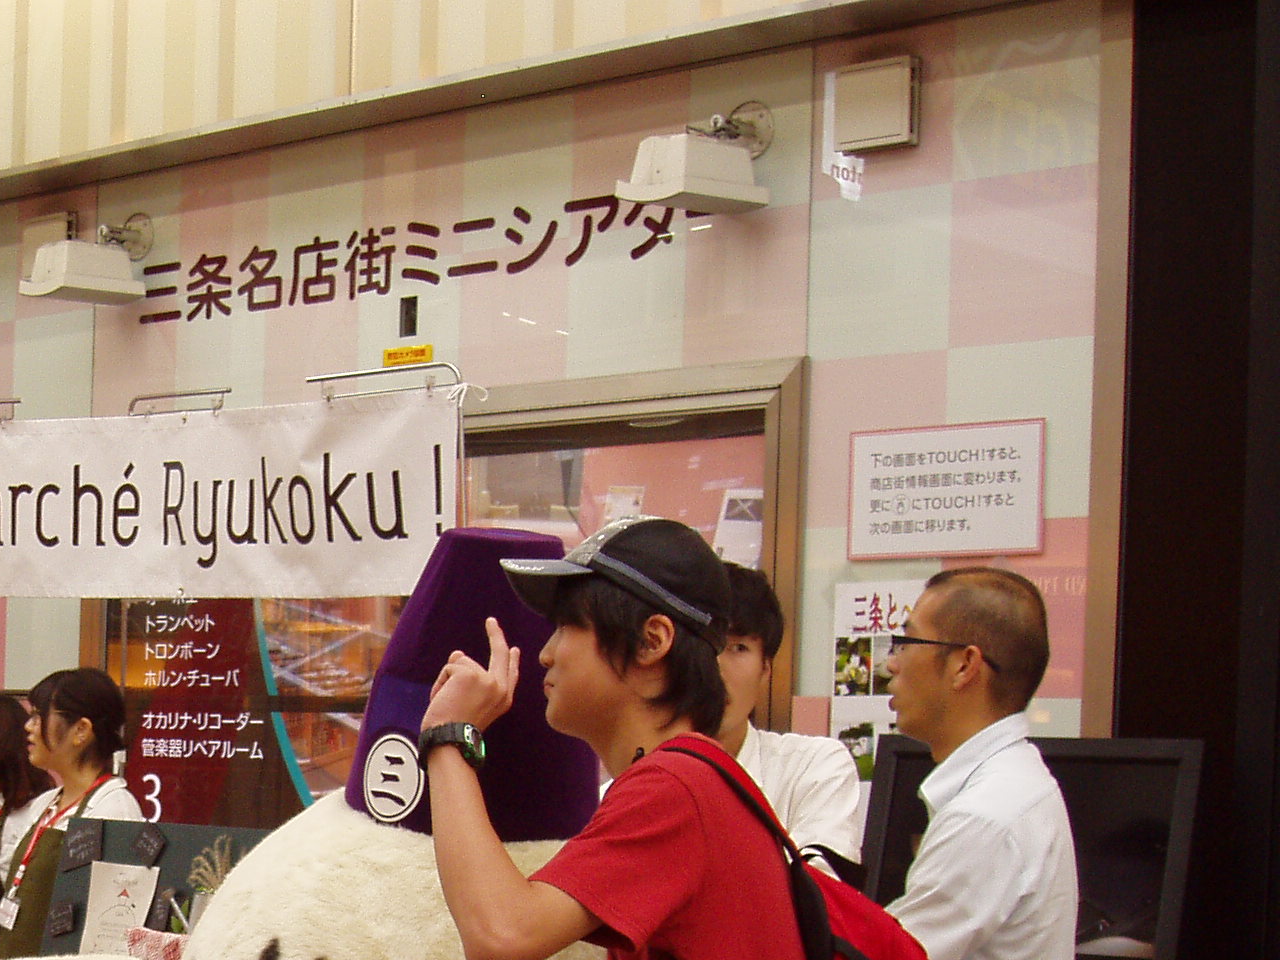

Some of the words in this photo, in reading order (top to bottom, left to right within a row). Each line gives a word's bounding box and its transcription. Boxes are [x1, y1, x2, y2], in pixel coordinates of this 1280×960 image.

[139, 193, 713, 324] 三条名店街ミニシアタ
[163, 451, 409, 569] Ryukoku
[145, 613, 215, 633] トランペット
[144, 641, 220, 660] トロンボーン
[144, 668, 240, 687] ホルン・チューバ
[142, 712, 264, 731] オカリナ・リコーダー
[141, 738, 264, 760] 管楽器リペアルーム
[142, 773, 162, 822] 3
